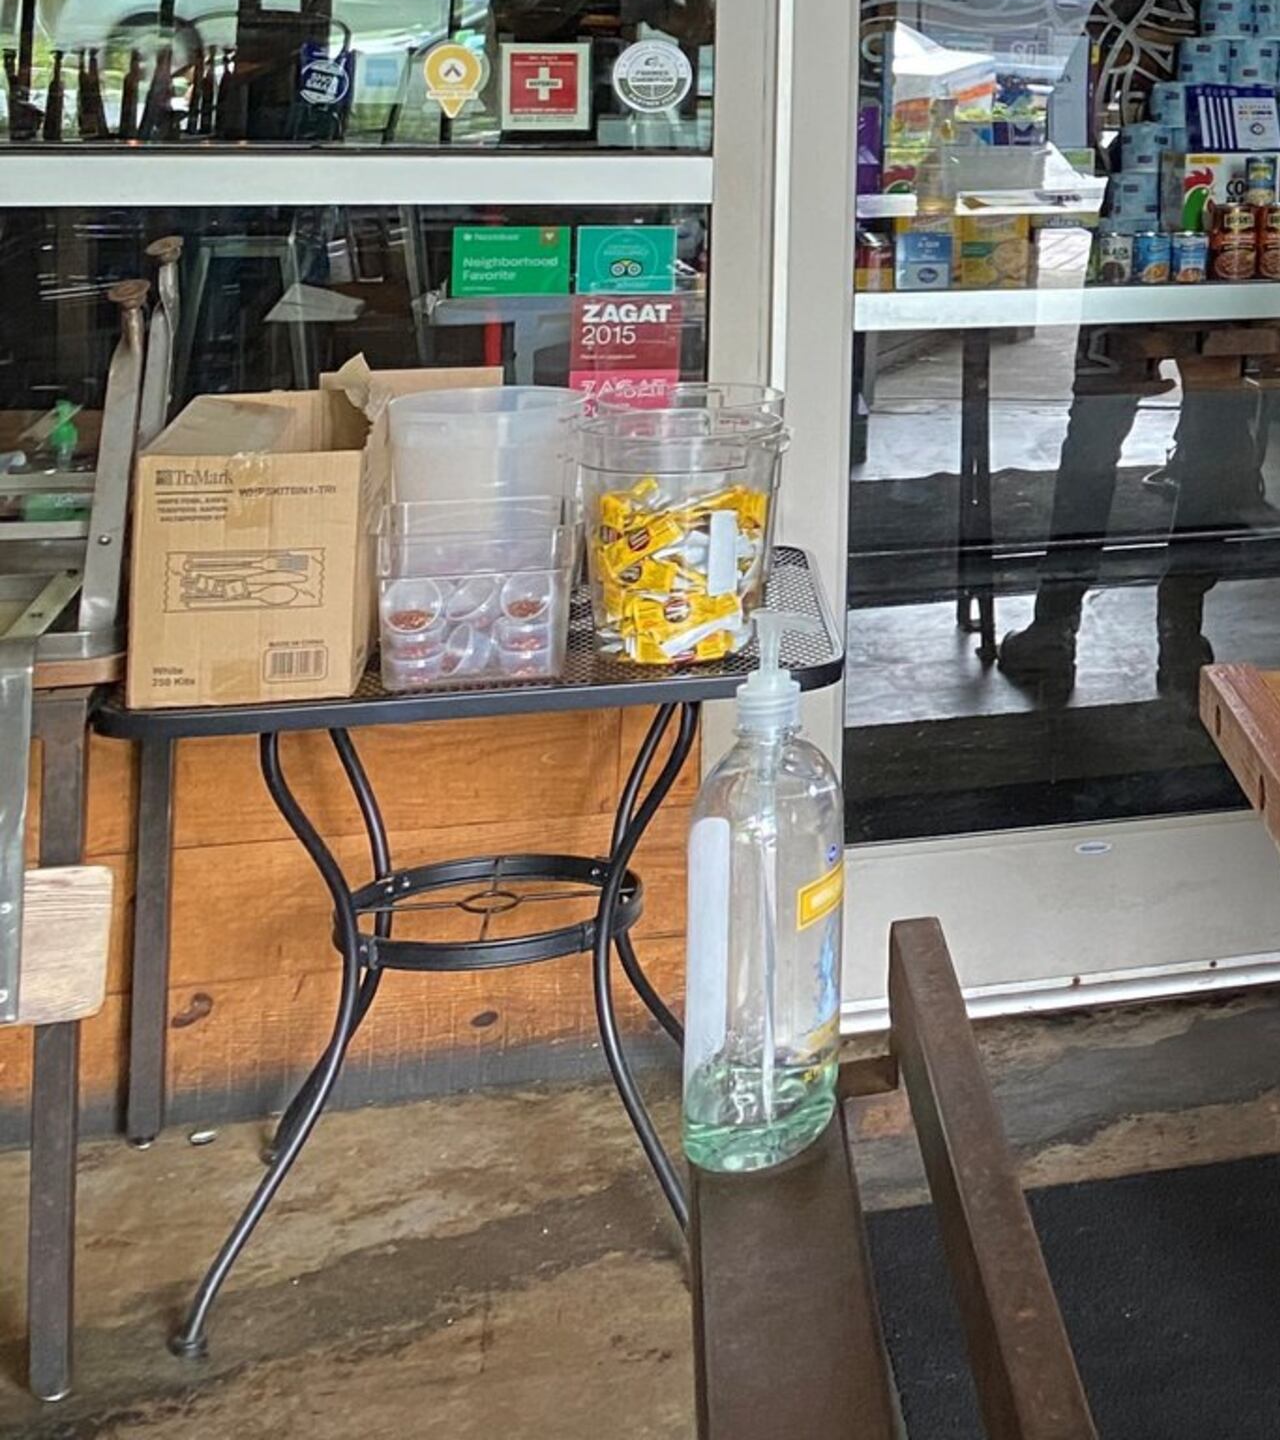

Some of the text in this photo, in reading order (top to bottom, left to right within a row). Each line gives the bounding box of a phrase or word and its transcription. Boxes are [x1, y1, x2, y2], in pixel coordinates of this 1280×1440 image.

[462, 256, 559, 269] Neighborhood
[462, 269, 517, 281] Favorite
[581, 302, 673, 324] ZAGAT
[580, 324, 637, 346] 2015
[175, 469, 233, 486] TriMark
[152, 666, 184, 676] White
